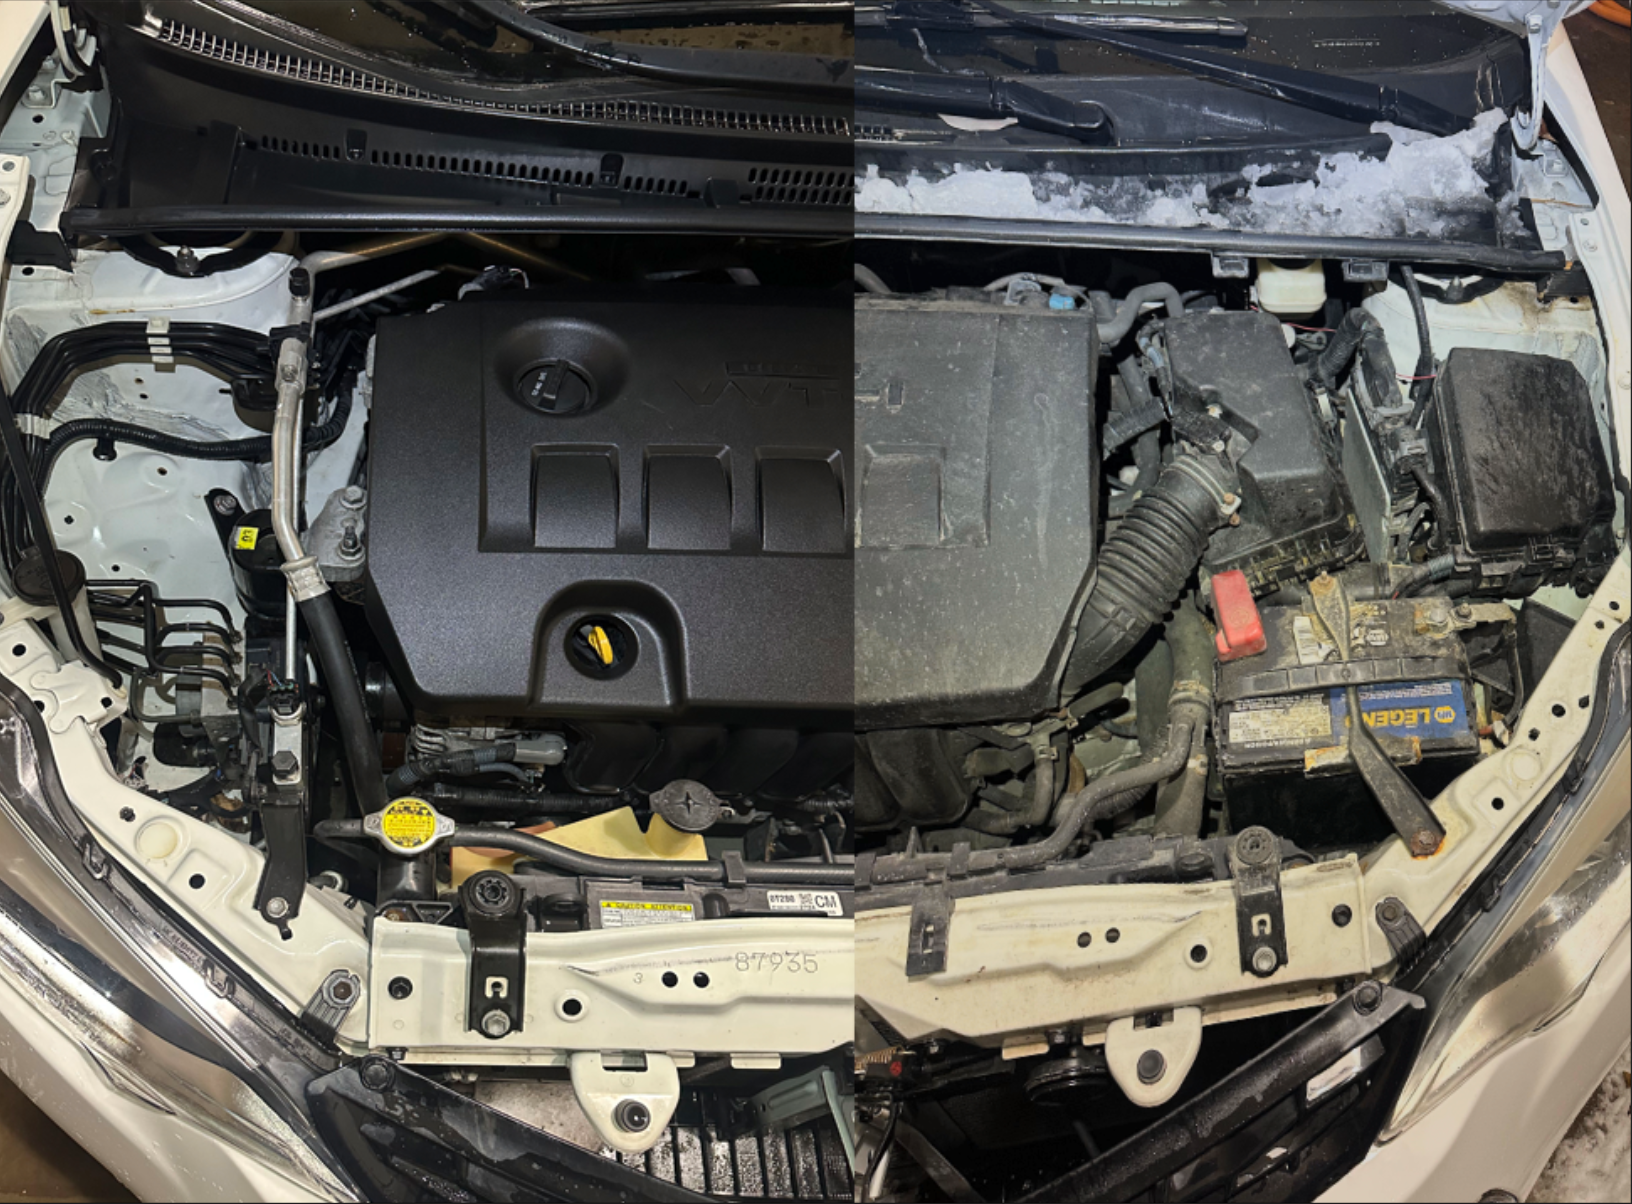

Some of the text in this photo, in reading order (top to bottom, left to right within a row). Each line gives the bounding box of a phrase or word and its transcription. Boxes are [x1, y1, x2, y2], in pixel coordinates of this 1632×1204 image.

[1345, 706, 1431, 728] LEGEN
[815, 895, 838, 908] CM
[734, 951, 818, 974] 87935
[633, 972, 643, 984] 3
